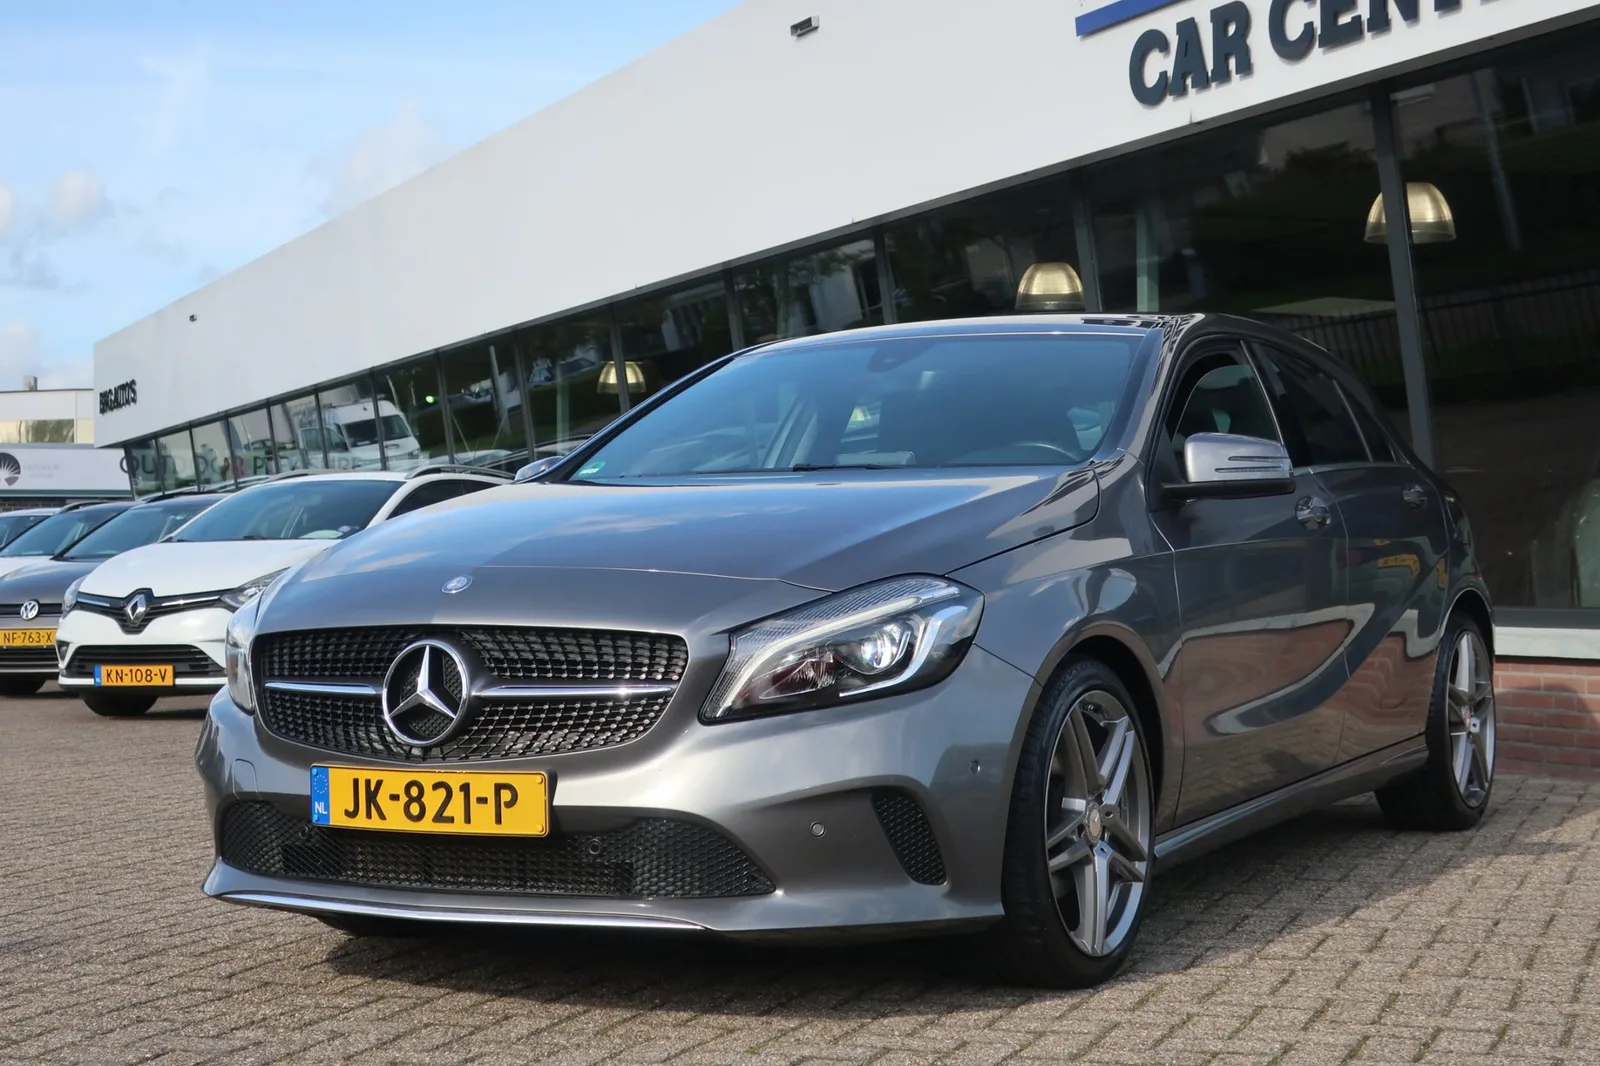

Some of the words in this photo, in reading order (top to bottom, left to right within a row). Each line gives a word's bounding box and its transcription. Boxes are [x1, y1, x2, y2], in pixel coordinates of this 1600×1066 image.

[1129, 0, 1252, 104] CAR
[1269, 0, 1463, 60] CE
[3, 631, 53, 644] NF-763-X
[106, 668, 167, 683] KN-108-V
[314, 801, 328, 815] NL
[344, 777, 519, 825] JK-821-P
